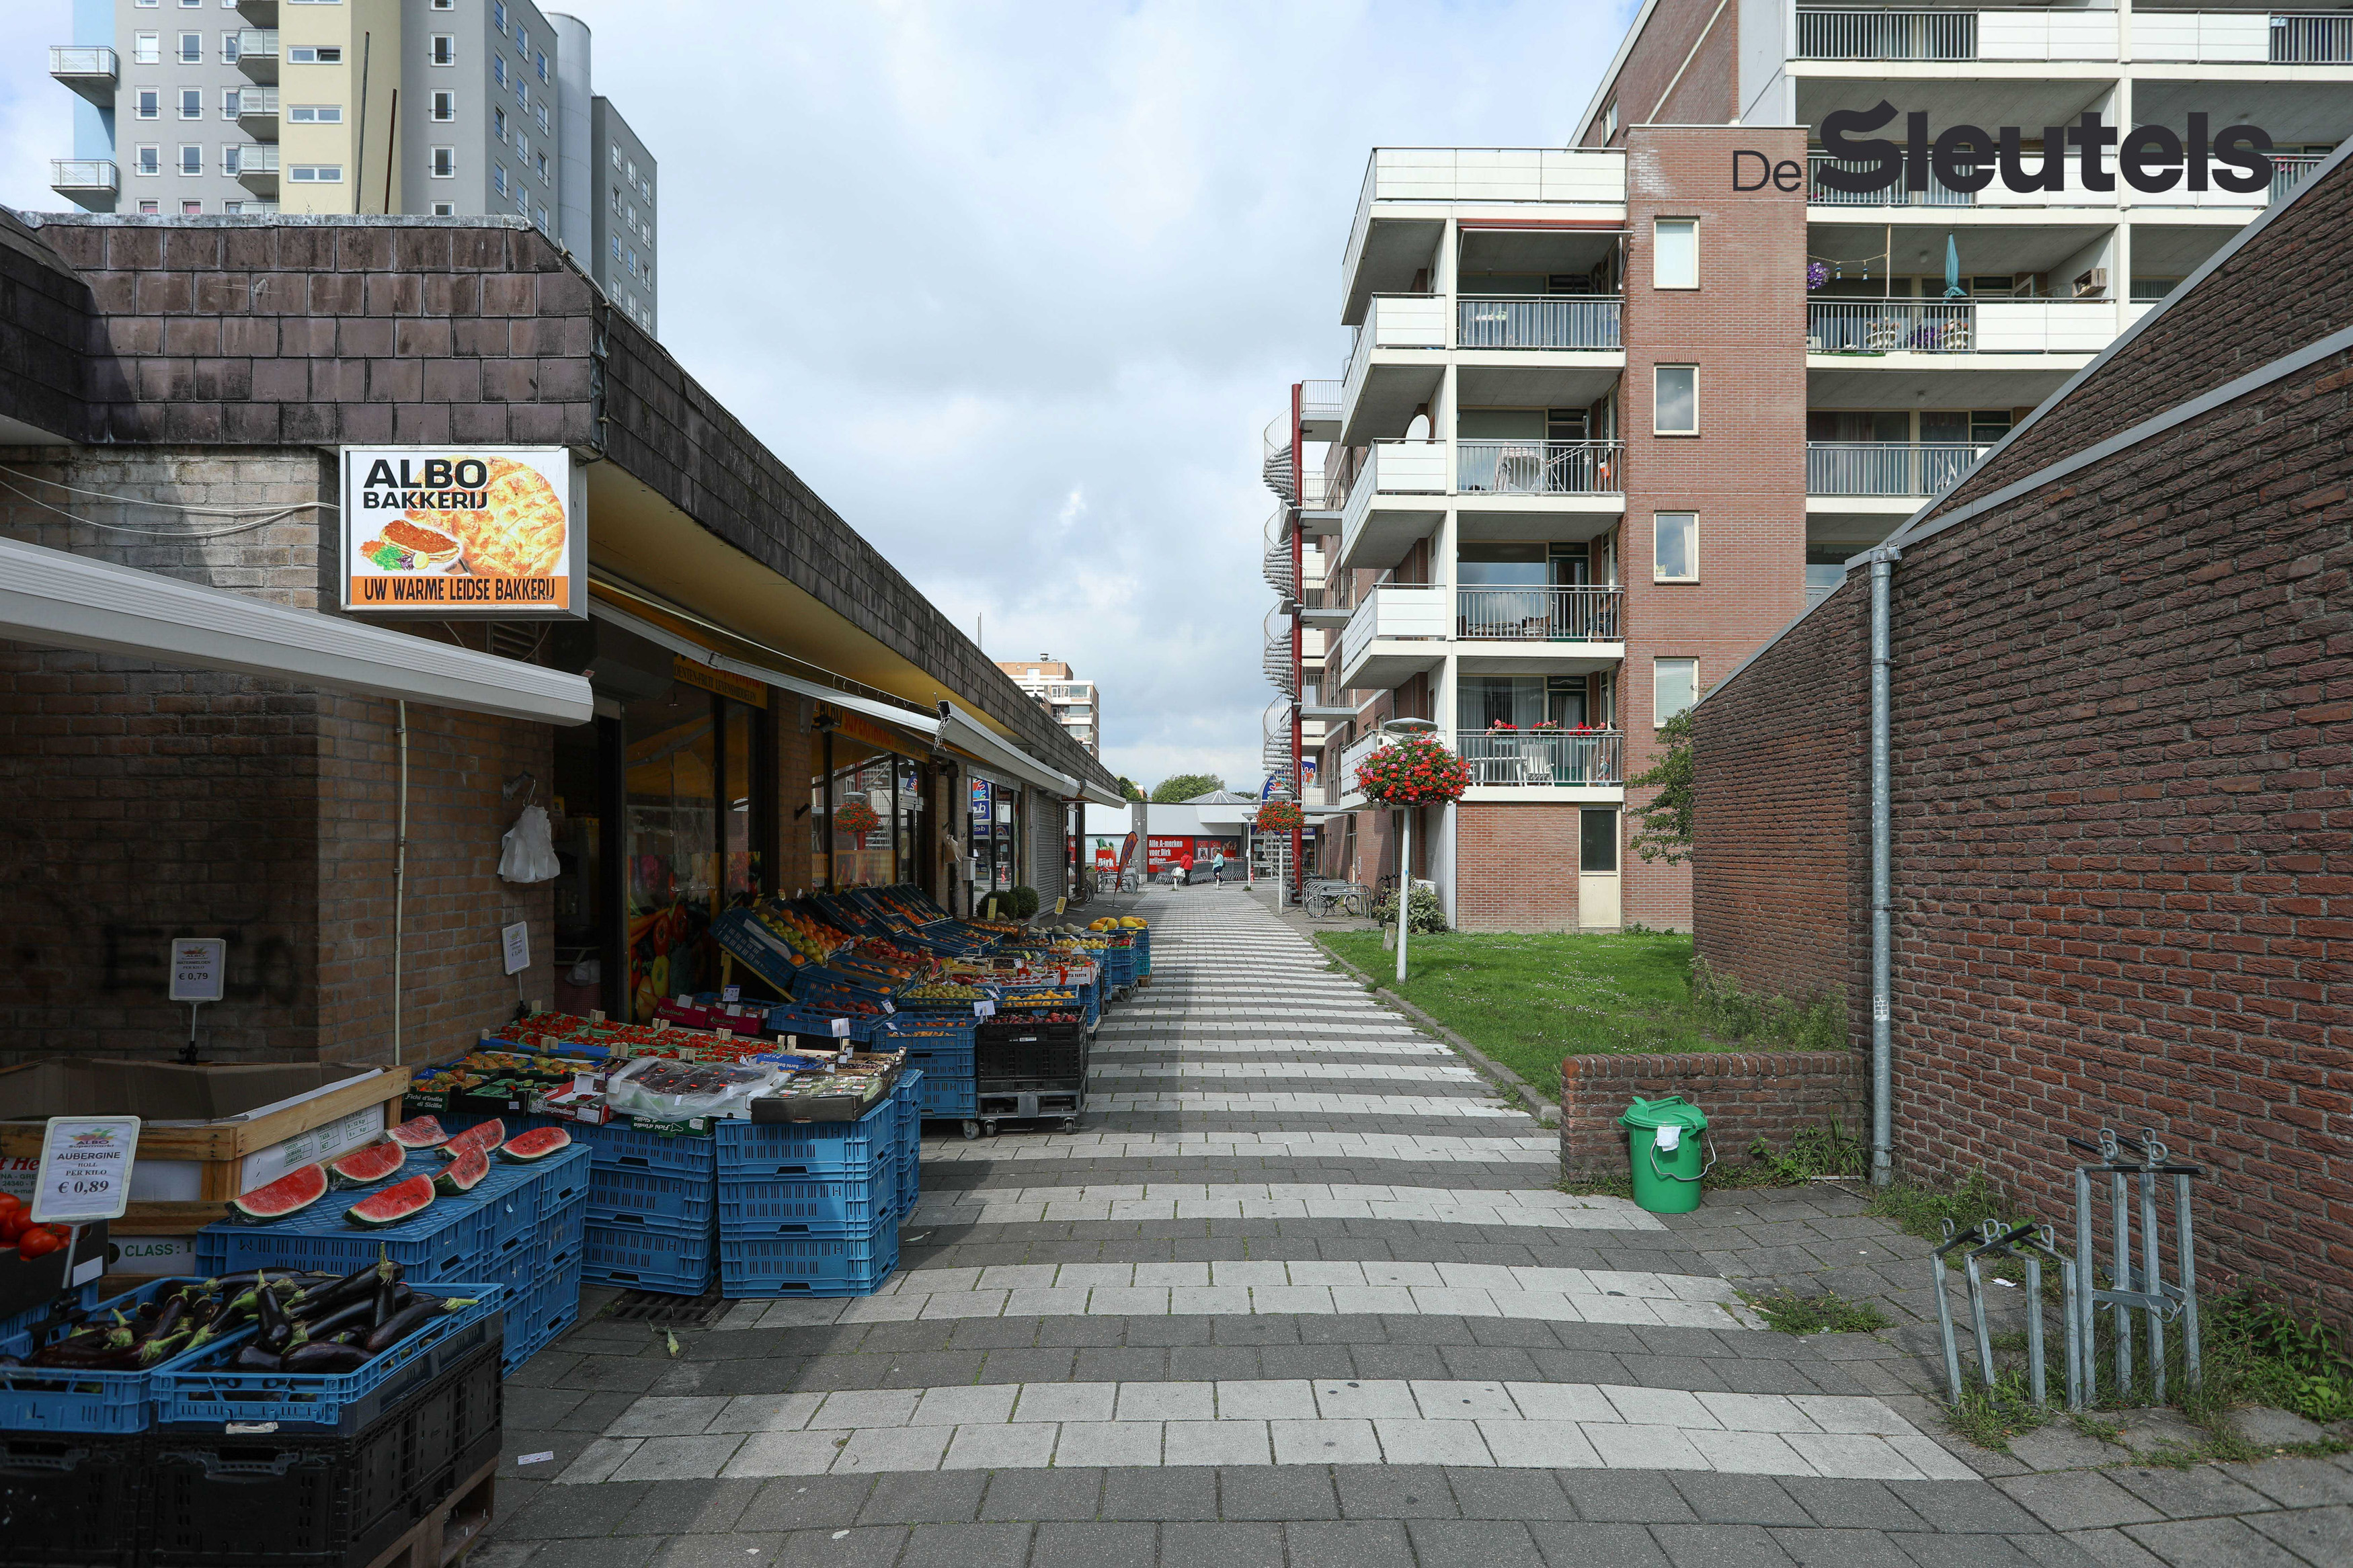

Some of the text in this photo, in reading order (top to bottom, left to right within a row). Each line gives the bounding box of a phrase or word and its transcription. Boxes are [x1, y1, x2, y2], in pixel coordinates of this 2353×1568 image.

[363, 459, 487, 489] ALBO
[363, 491, 488, 509] BAKKERIJ
[364, 579, 555, 600] UW WARME LEIDSE BAKKERIJ
[1160, 839, 1183, 848] A-merken
[1160, 848, 1171, 856] Dirk
[1097, 858, 1114, 867] Dirk
[188, 973, 208, 981] 0,79
[657, 1005, 686, 1017] Quelinda
[709, 1015, 737, 1026] Quelinda
[405, 1093, 443, 1102] Fichi d'india
[319, 1132, 330, 1141] TARA
[57, 1152, 121, 1161] AUBERGINE
[58, 1180, 109, 1196] € 0,89
